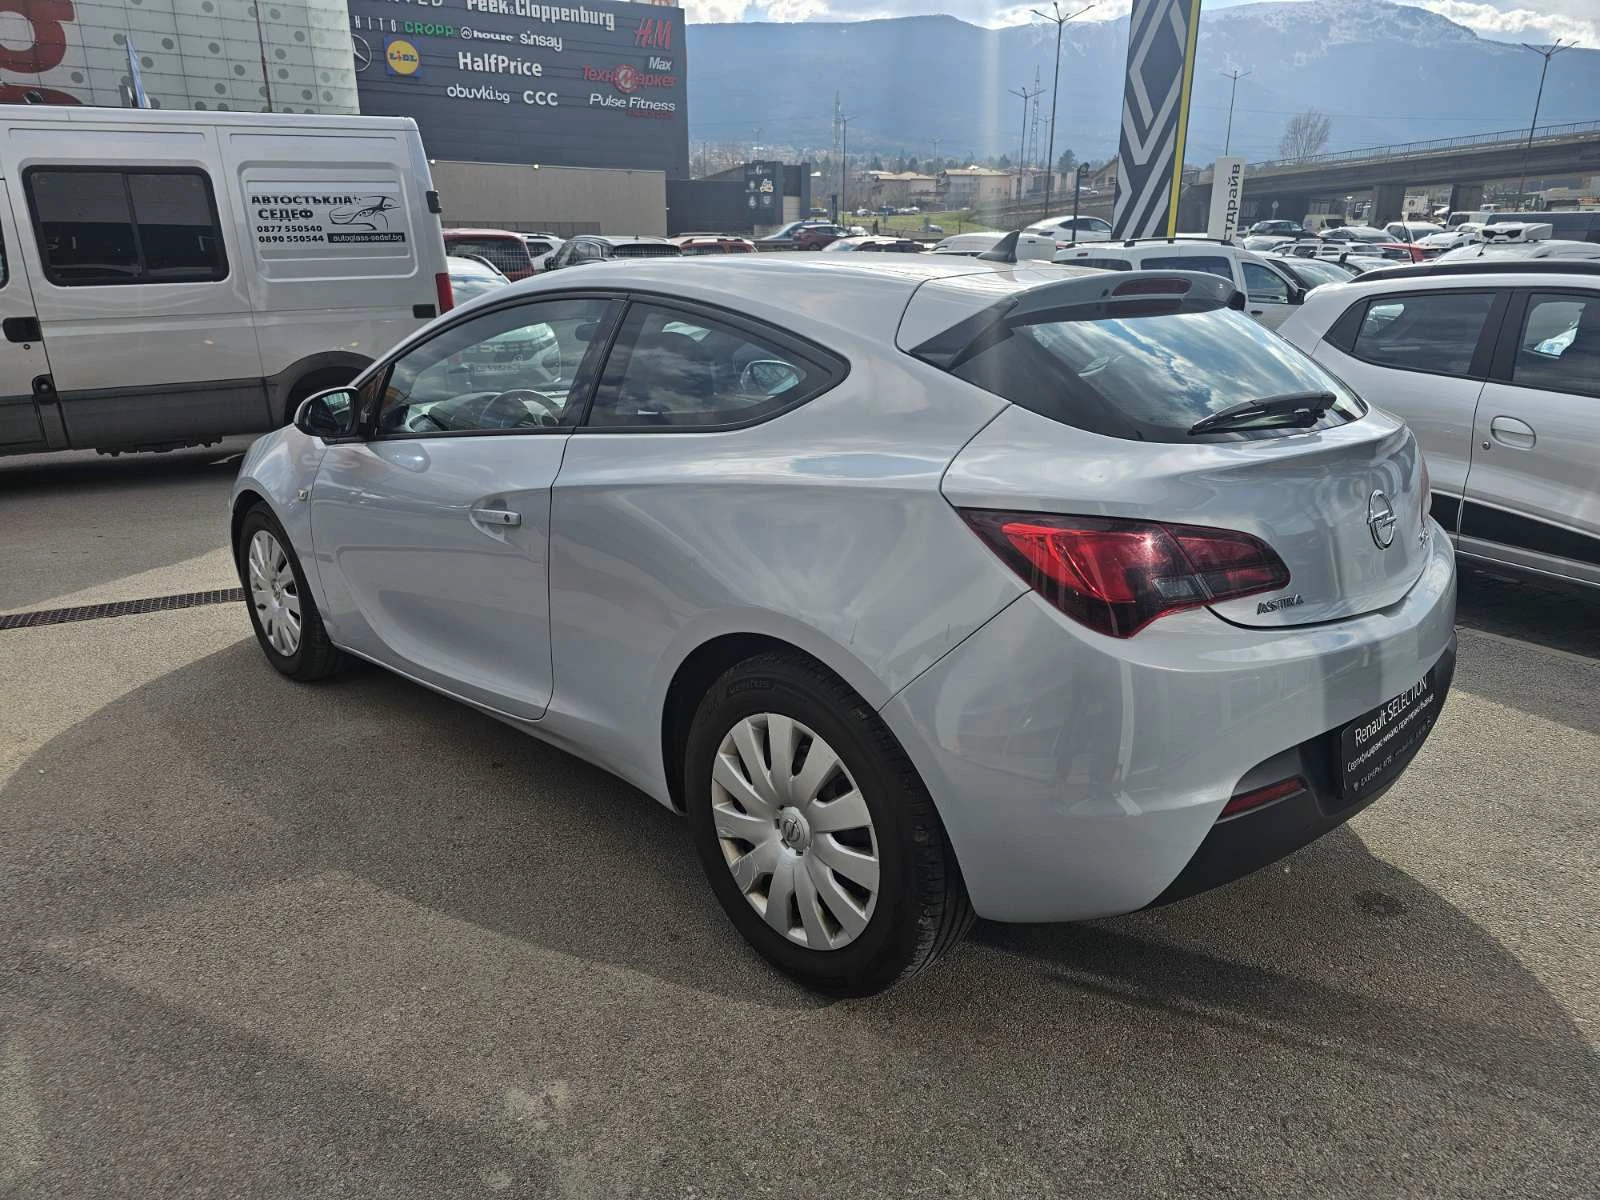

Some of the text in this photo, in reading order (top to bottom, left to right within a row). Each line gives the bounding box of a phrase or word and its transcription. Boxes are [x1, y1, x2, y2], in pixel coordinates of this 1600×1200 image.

[354, 15, 397, 33] HITO
[404, 21, 454, 37] CROPP
[634, 16, 672, 49] H&M
[519, 31, 563, 51] sinsay
[458, 51, 543, 77] HalfPrice
[648, 56, 672, 71] Max
[447, 84, 511, 104] obuvki.bg
[523, 90, 559, 106] CCC
[589, 93, 676, 112] Pulse Fitness
[251, 194, 353, 206] АВТОСТЪКЛА
[257, 208, 314, 222] СЕДЕФ
[257, 225, 322, 233] 0877 550540
[258, 235, 325, 243] 0890 550544
[1354, 674, 1428, 748] Renault SELECTION
